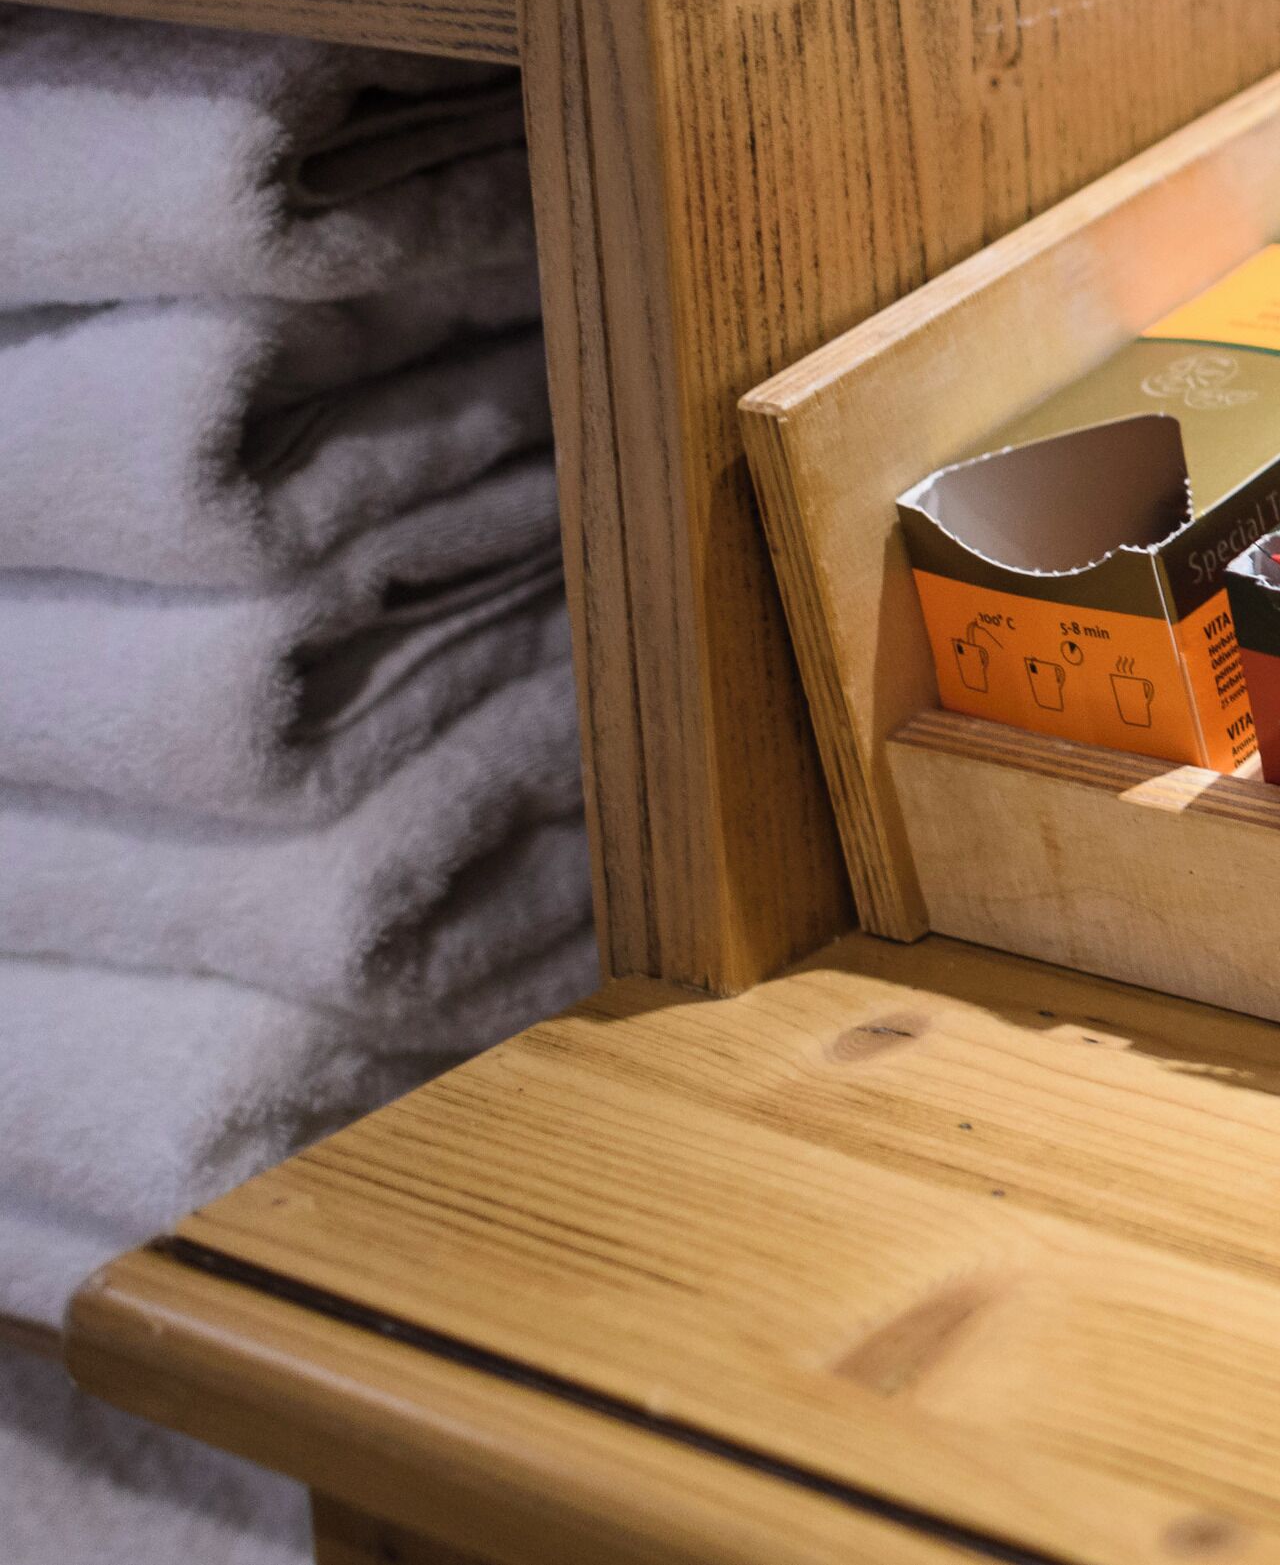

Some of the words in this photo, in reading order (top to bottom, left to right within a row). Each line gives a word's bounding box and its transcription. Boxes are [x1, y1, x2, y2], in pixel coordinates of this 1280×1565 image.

[1188, 506, 1266, 583] Special
[1006, 617, 1017, 631] C
[1060, 621, 1082, 637] 5-8
[1084, 625, 1110, 641] min
[1203, 612, 1232, 640] VITA
[1226, 712, 1253, 740] VITA
